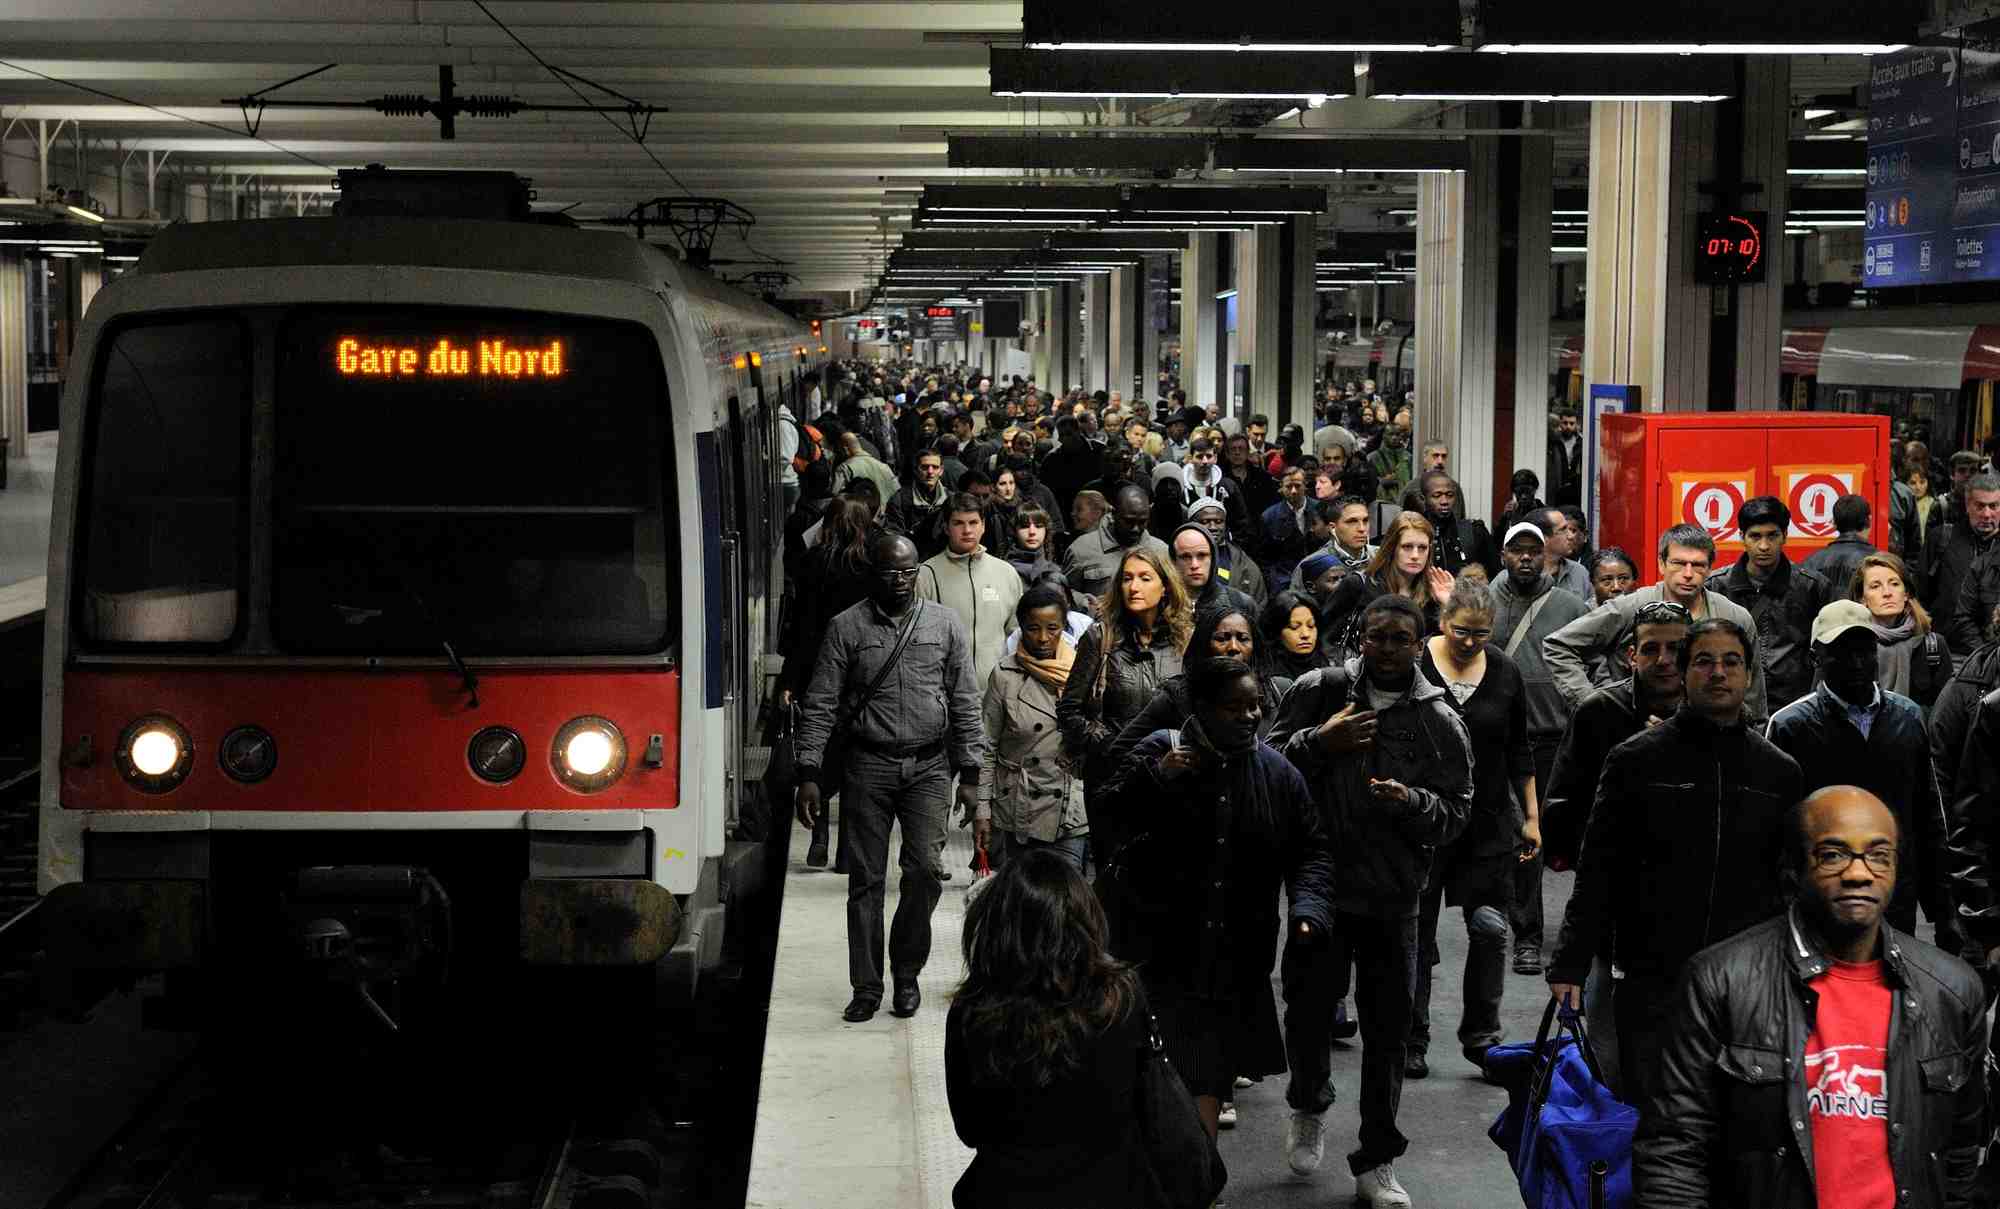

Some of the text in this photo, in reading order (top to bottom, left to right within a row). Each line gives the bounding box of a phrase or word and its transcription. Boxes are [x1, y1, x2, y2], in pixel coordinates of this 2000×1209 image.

[1911, 55, 1936, 76] trains
[1707, 239, 1755, 256] 07:10
[1956, 238, 1984, 256] Toilettes
[338, 338, 562, 375] Gare du Nord
